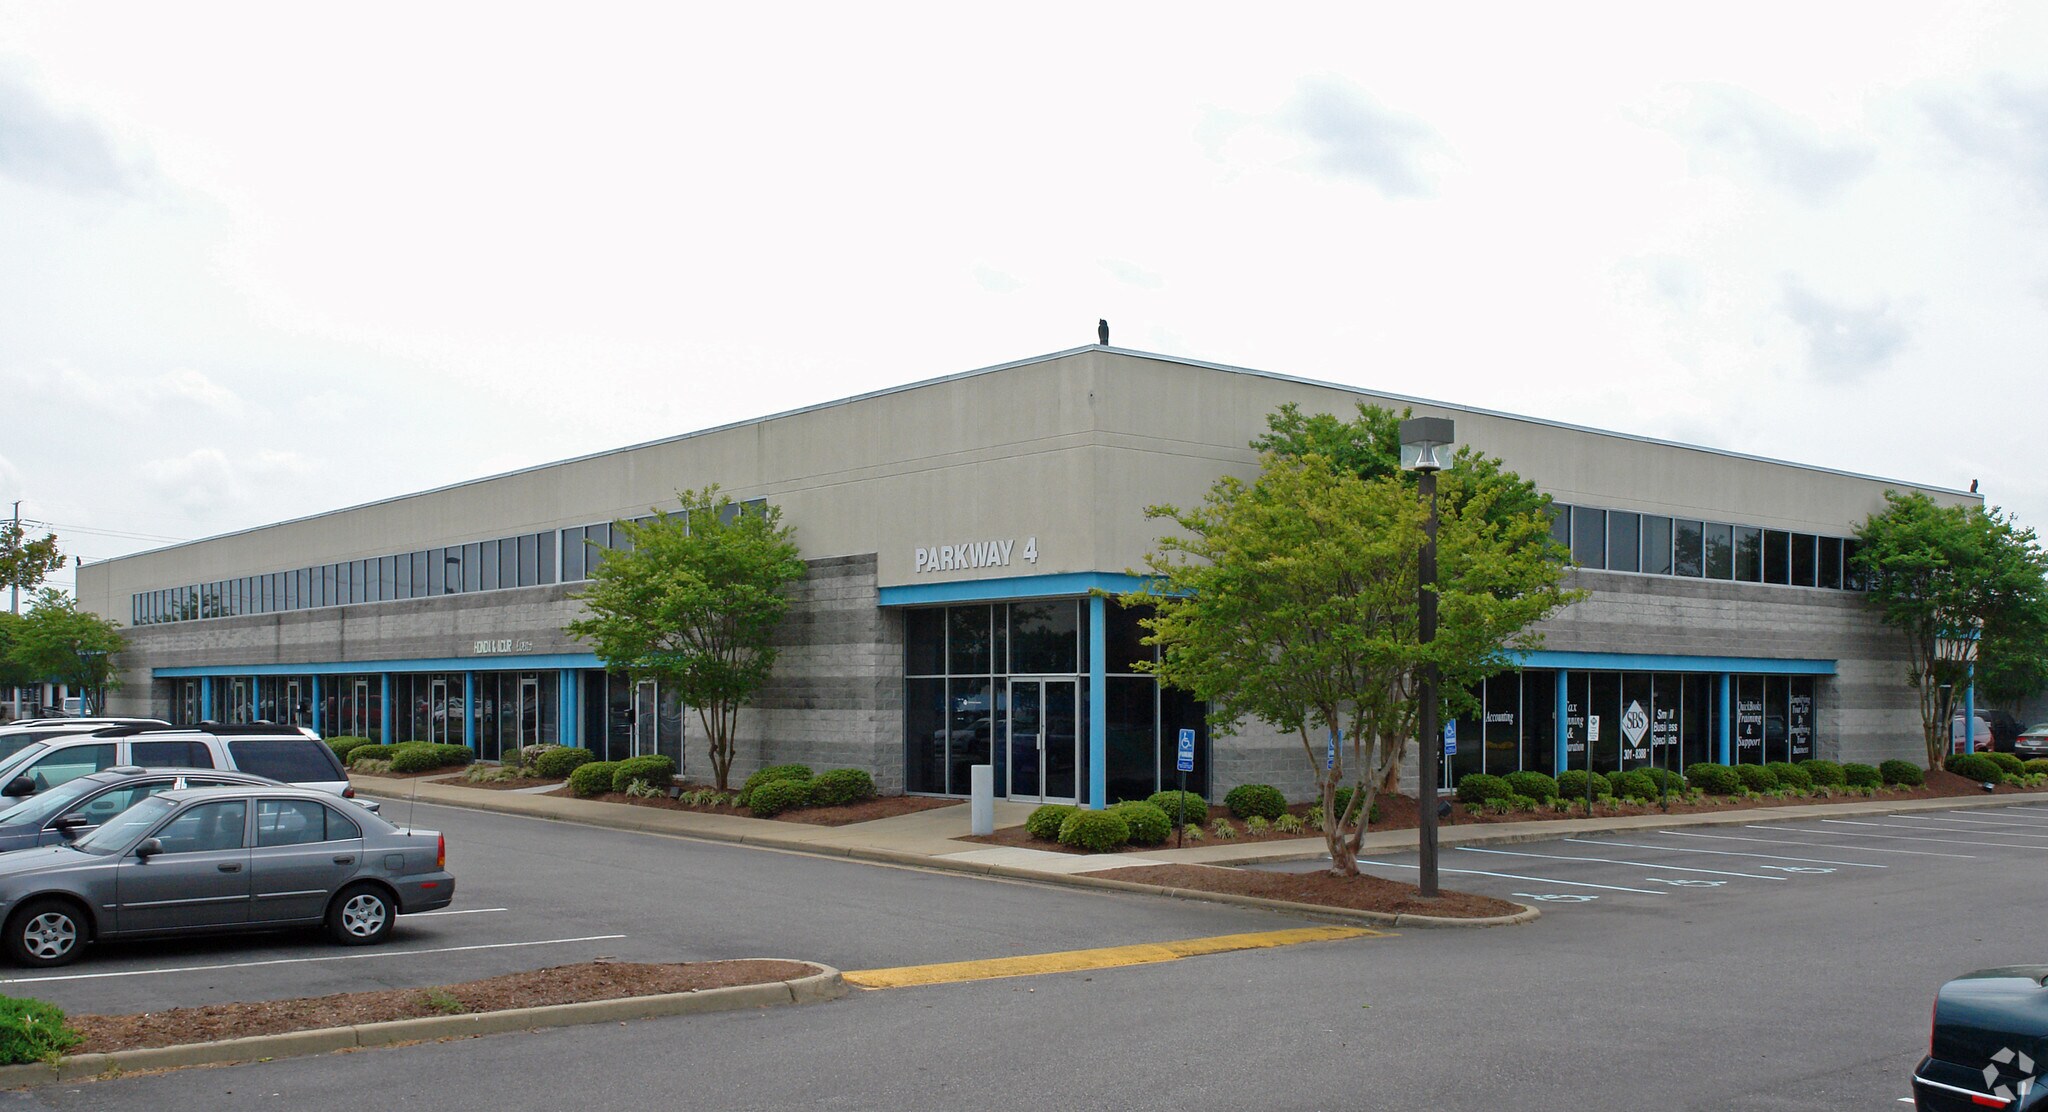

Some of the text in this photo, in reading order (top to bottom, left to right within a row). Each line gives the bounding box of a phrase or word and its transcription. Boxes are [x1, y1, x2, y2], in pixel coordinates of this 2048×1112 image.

[915, 536, 1039, 573] PARKWAY 4
[1567, 700, 1578, 712] ax
[1485, 710, 1514, 725] Accounting
[1626, 711, 1644, 730] SBS
[1656, 708, 1675, 720] Smll
[1738, 712, 1762, 726] Training
[1653, 721, 1678, 732] Busiess
[1746, 724, 1753, 735] &
[1652, 734, 1677, 748] Speciists
[1738, 736, 1761, 749] Support
